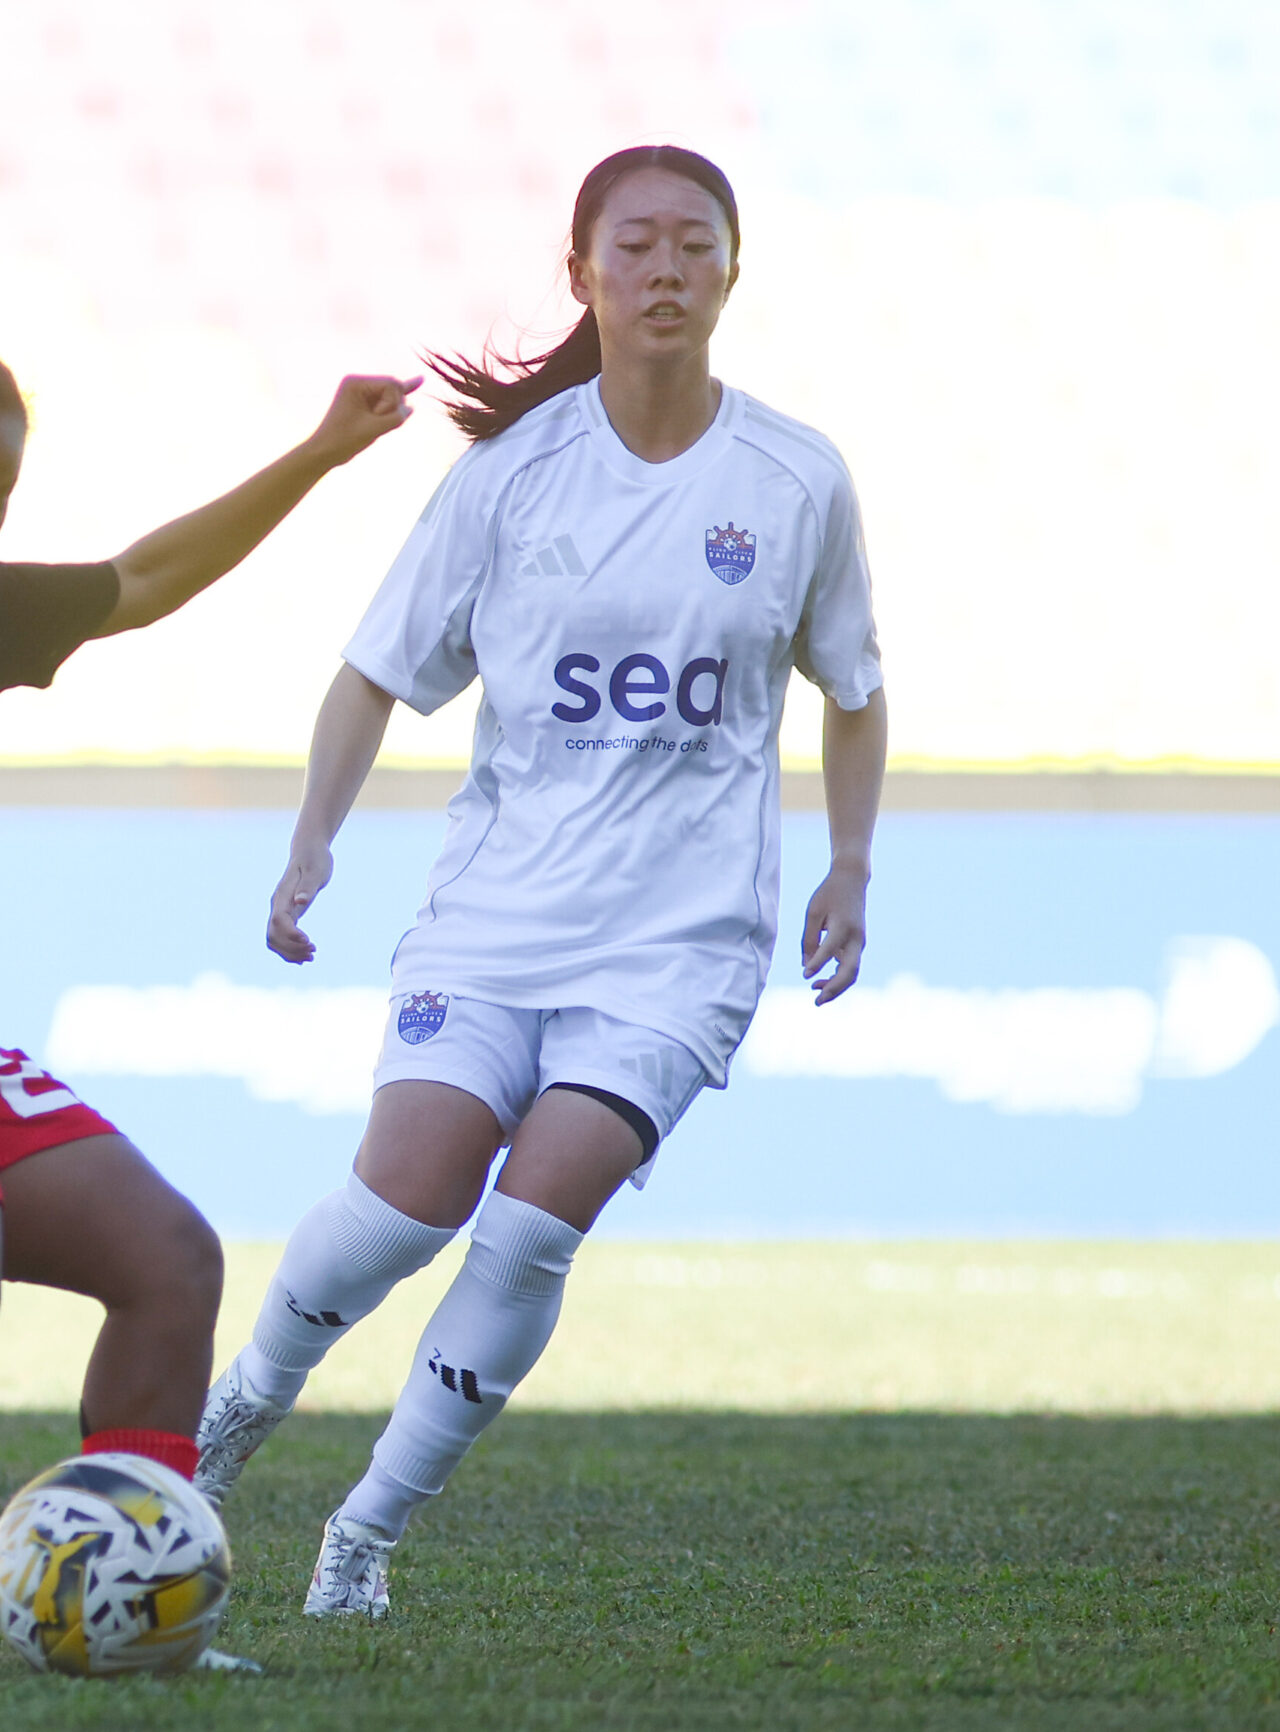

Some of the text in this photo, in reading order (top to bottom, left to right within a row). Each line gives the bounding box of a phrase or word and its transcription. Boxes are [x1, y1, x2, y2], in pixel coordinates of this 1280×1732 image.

[551, 653, 729, 727] sea
[565, 735, 649, 753] connecting
[651, 735, 676, 752] the
